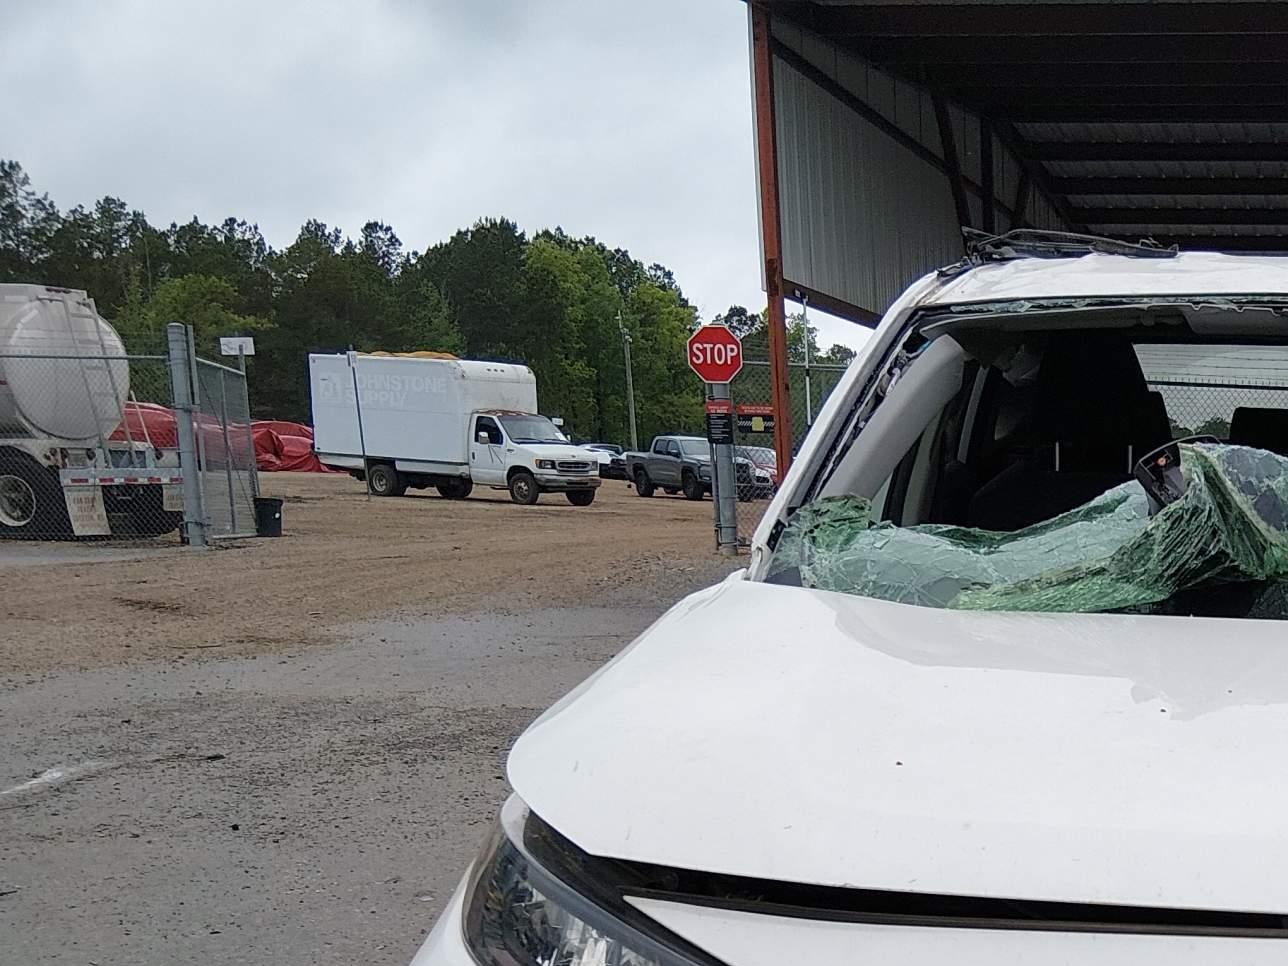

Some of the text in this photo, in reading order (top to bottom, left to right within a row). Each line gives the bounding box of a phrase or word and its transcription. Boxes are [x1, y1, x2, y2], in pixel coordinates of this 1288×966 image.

[692, 343, 738, 365] STOP
[344, 374, 447, 393] JOHNSTONE
[343, 388, 408, 408] SUPPLY
